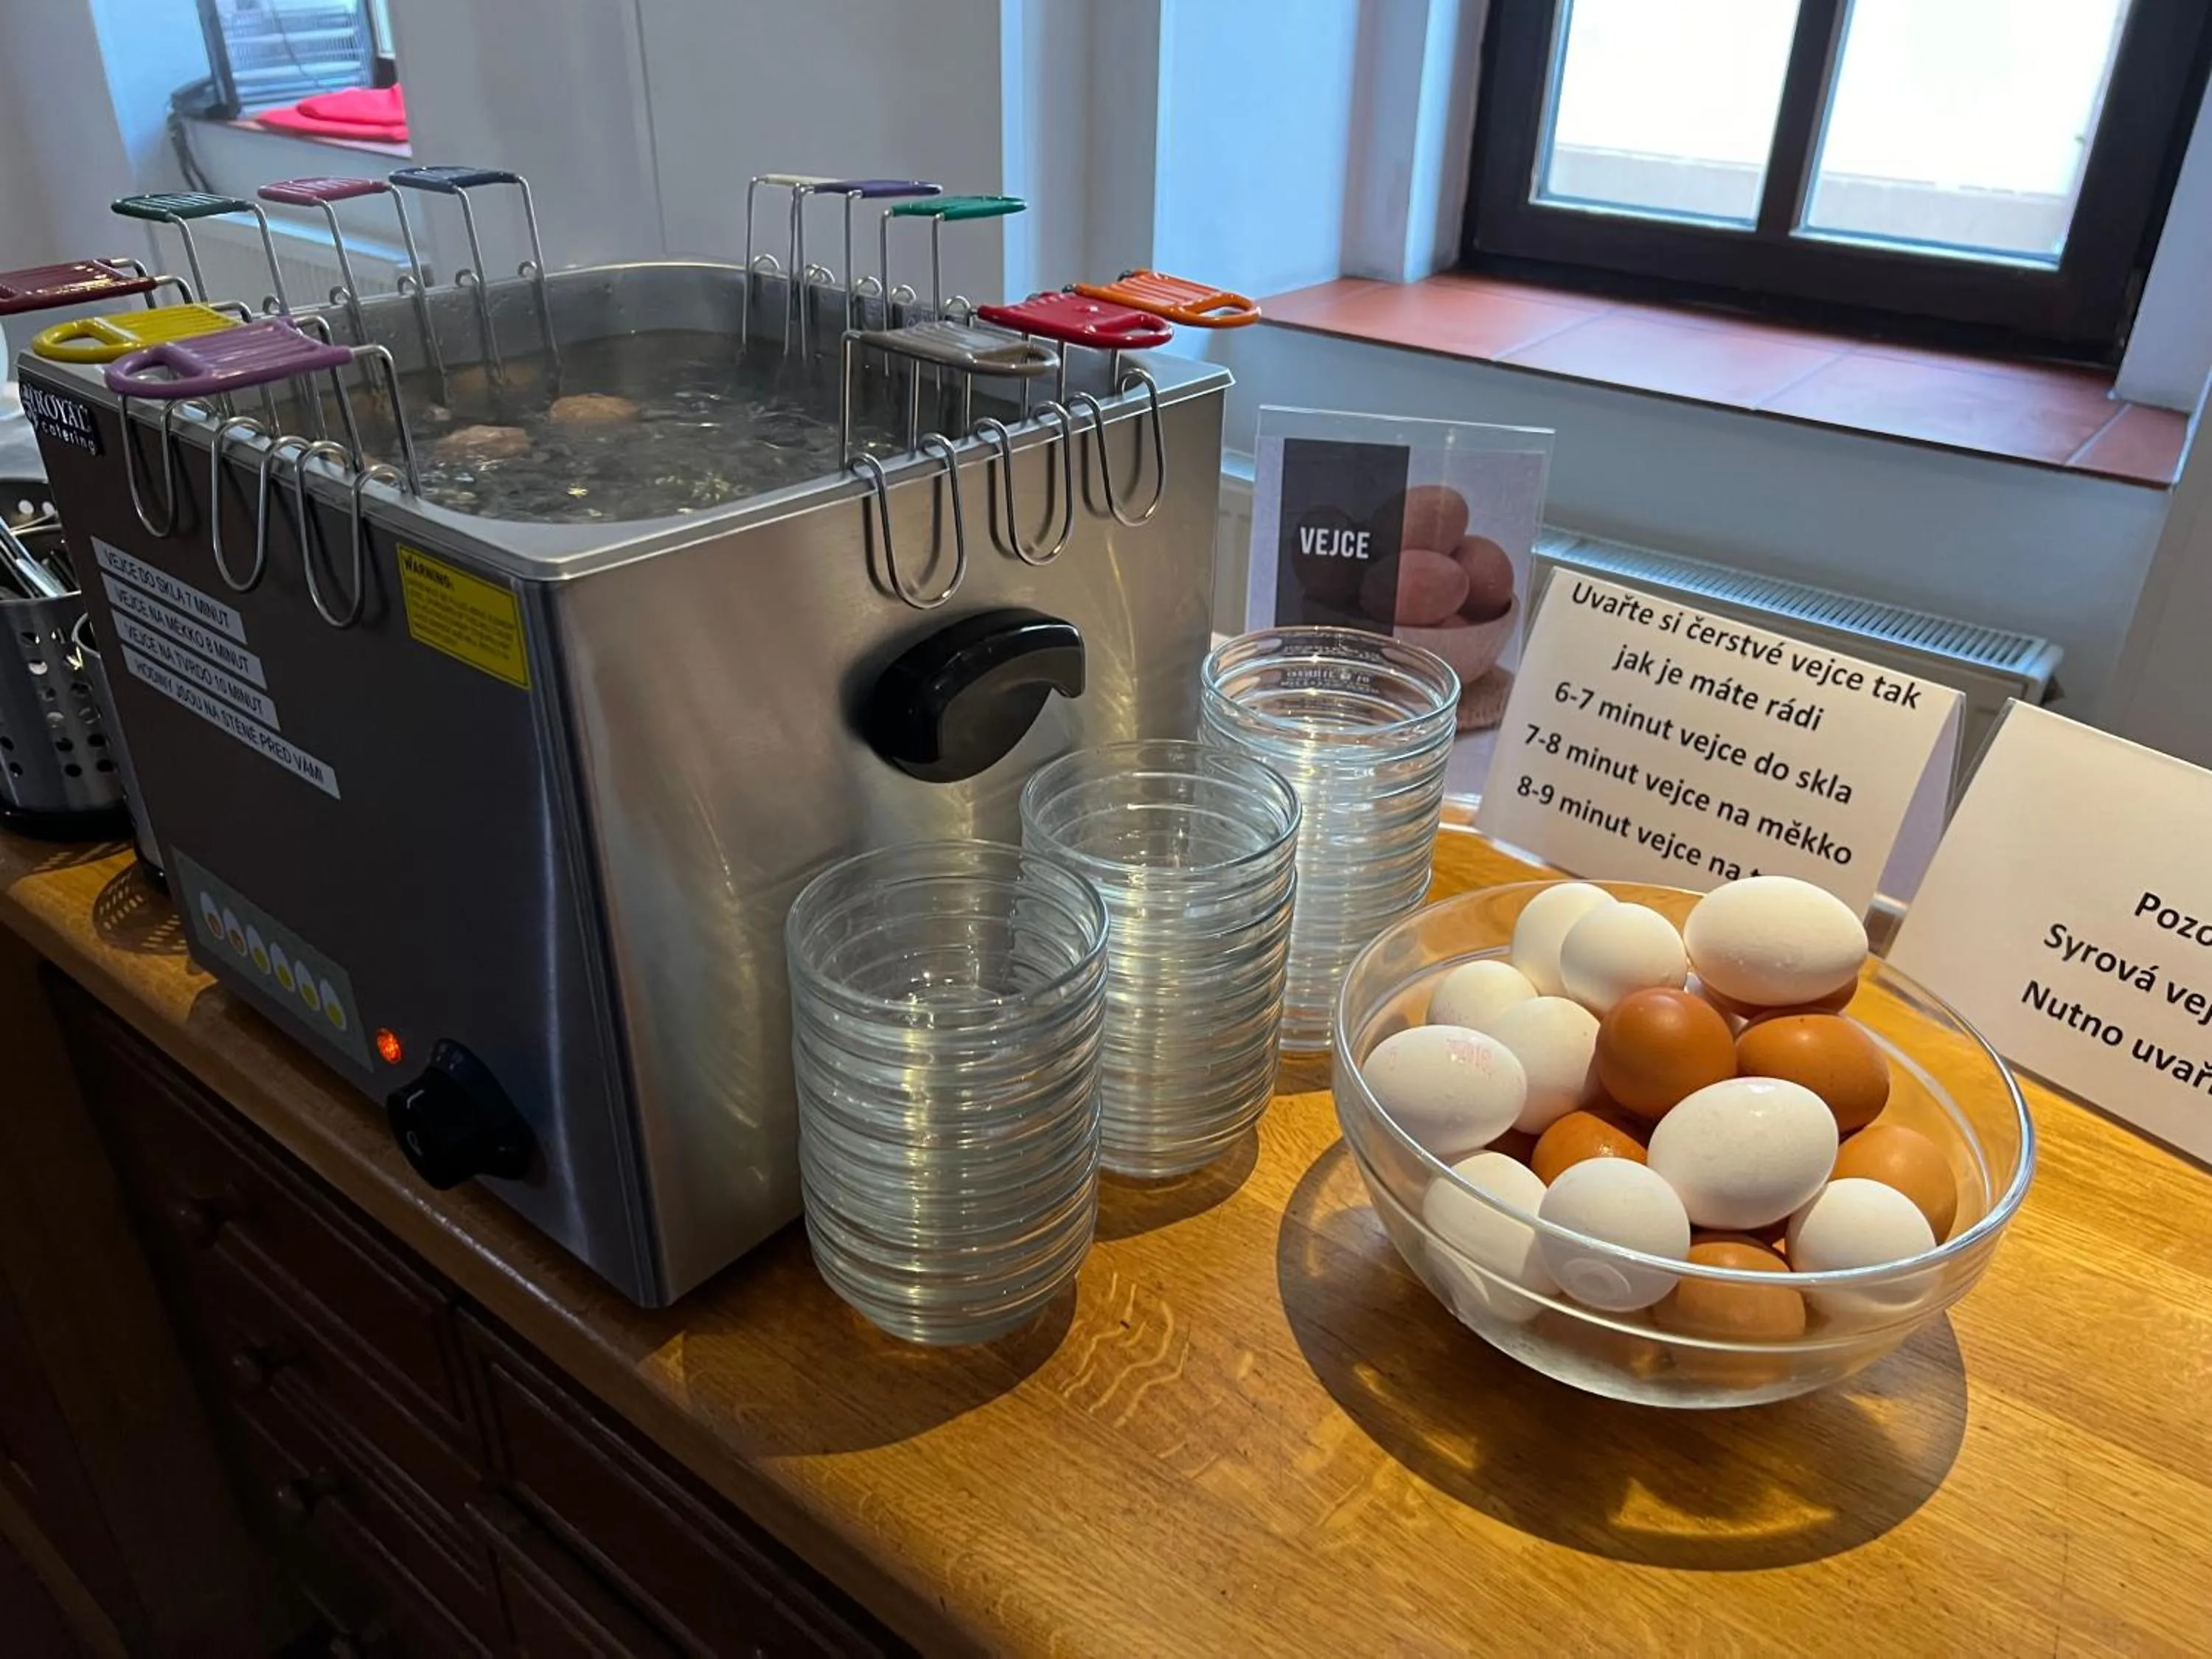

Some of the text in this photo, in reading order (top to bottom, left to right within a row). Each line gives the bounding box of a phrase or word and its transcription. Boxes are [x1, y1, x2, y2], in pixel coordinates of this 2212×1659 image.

[34, 390, 92, 434] ROYAL
[41, 422, 97, 456] catering
[1300, 526, 1371, 559] VEJCE
[103, 549, 229, 628] VEJCE DO SKLA 7 MINUT
[114, 586, 150, 618] VEJCE
[149, 605, 167, 627] NA
[213, 639, 249, 673] MINUT
[123, 622, 159, 654] VEJCE
[159, 641, 176, 664] NA
[174, 650, 212, 686] TVRDO
[227, 682, 264, 716] MINUT
[1571, 582, 1922, 710] Uvařte si čerstvé vejce tak
[1611, 644, 1825, 731] jak je máte rádi
[203, 699, 221, 721] NA
[1554, 681, 1853, 804] 6-7 minut vejce do skla
[1517, 775, 1741, 881] 8-9 minut vejce na
[1525, 723, 1852, 865] 7-8 minut vejce na měkko
[2043, 923, 2160, 993] Syrová
[2021, 980, 2212, 1096] Nutno uvař
